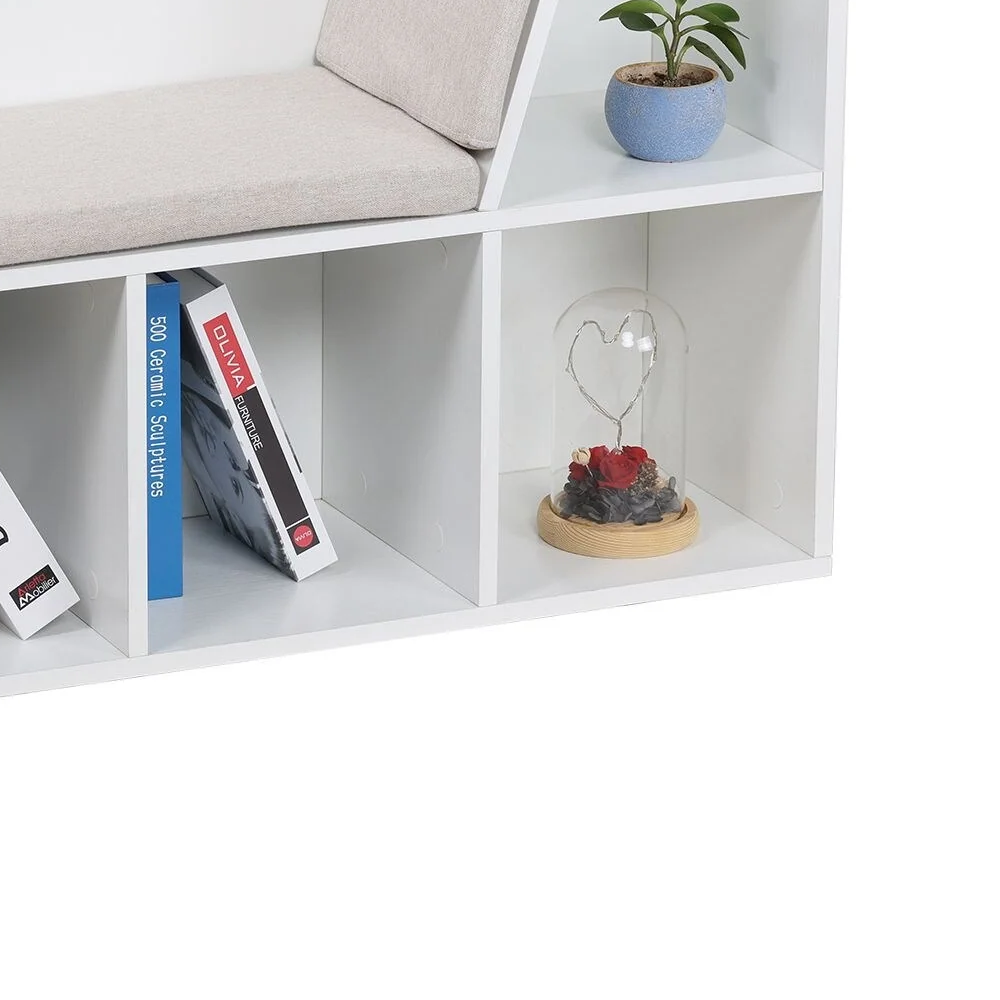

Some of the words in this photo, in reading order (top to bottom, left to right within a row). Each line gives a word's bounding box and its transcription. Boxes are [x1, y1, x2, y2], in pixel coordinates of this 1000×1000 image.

[150, 316, 167, 342] 500
[213, 324, 245, 389] OLIVIA
[150, 349, 167, 408] Ceramic
[235, 396, 264, 451] FURNITURE
[149, 415, 167, 498] Sculptures
